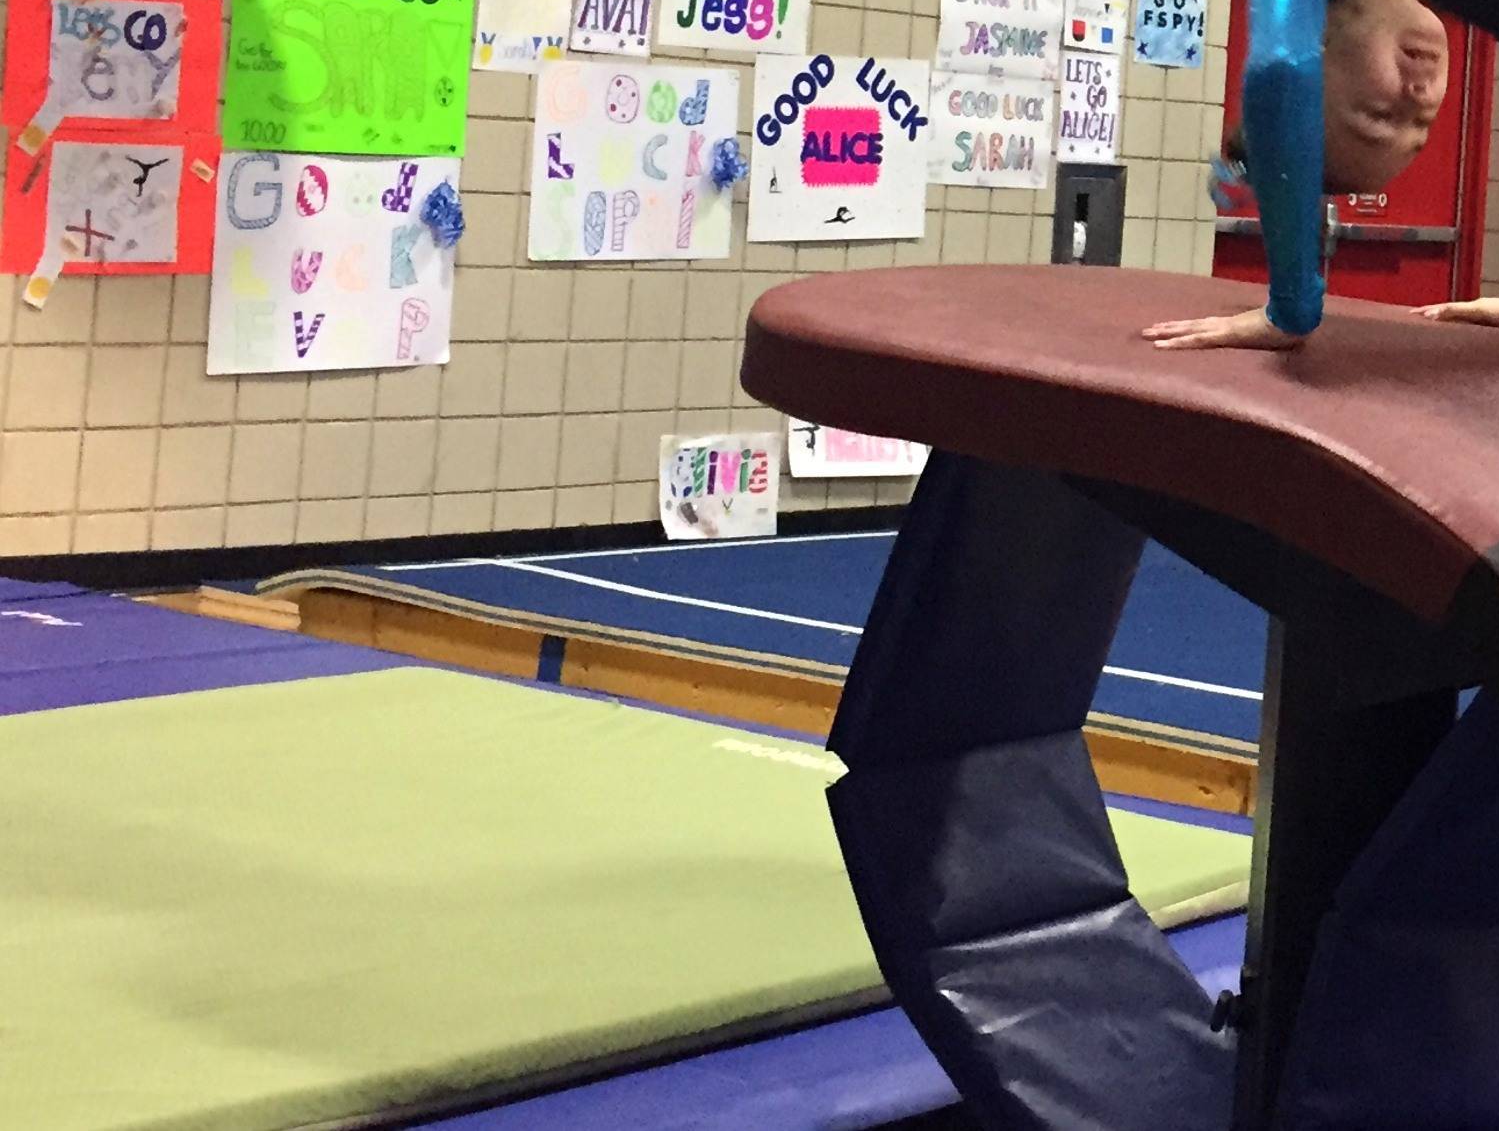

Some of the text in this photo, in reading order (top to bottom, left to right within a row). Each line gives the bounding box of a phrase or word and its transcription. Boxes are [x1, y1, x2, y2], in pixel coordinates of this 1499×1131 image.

[123, 9, 168, 51] GO
[960, 20, 1049, 59] JASMINE
[1065, 59, 1102, 84] LETS
[757, 54, 929, 147] GOOD LUCK
[948, 89, 1045, 122] GOOD LUCK
[1086, 85, 1107, 109] GO
[800, 131, 884, 165] ALICE
[1061, 109, 1116, 149] ALICE!
[951, 130, 1036, 173] SARAH
